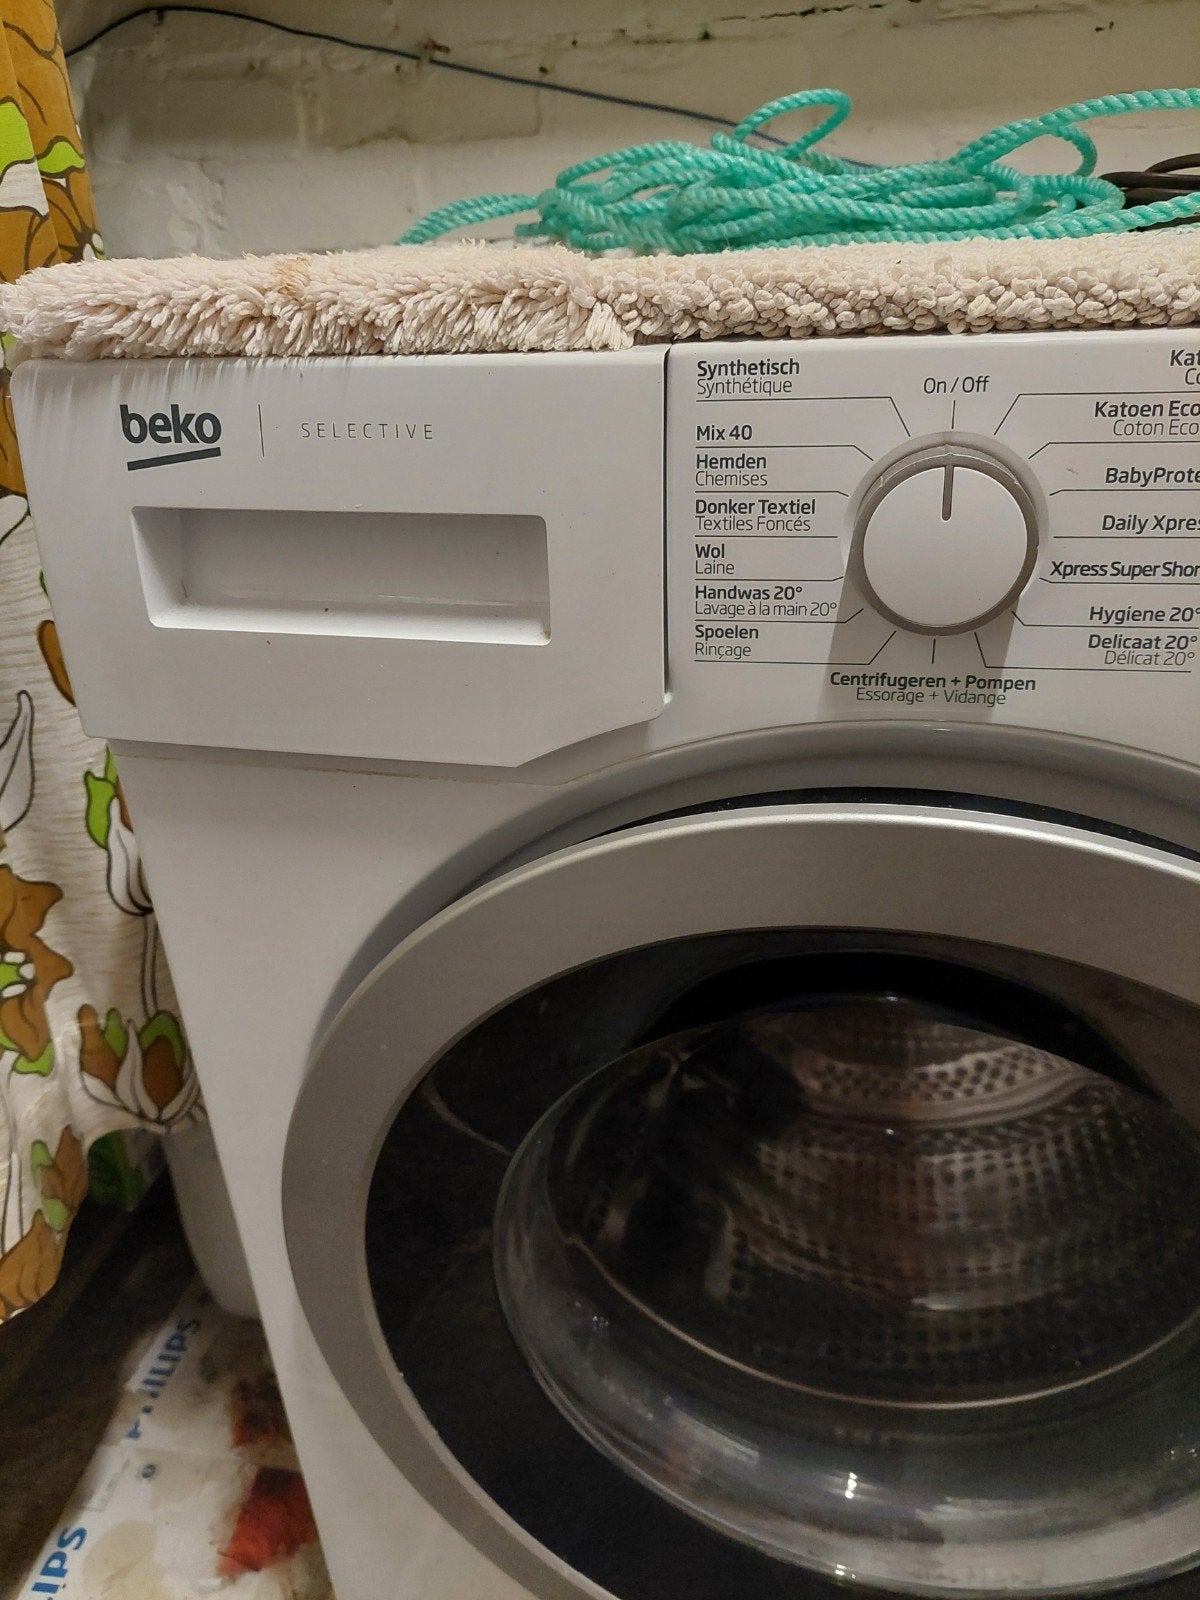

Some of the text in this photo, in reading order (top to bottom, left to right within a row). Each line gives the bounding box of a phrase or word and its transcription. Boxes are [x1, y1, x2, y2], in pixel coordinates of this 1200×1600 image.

[698, 358, 799, 379] Synthetisch
[697, 378, 792, 398] Synthétique
[1095, 400, 1200, 417] Katoen Eco
[120, 404, 221, 444] beko
[302, 422, 433, 440] SELECTIVE
[697, 425, 752, 440] Mix 40
[1113, 419, 1199, 436] Coton Eco
[697, 453, 766, 469] Hemden
[696, 471, 767, 486] Chemises
[696, 499, 815, 514] Donker Textiel
[695, 516, 810, 531] Textiles Foncés
[1102, 515, 1149, 534] Daily
[696, 544, 724, 558] Wol
[696, 560, 734, 574] Laine
[1050, 561, 1108, 579] Xpress
[1110, 561, 1161, 580] Super
[696, 585, 802, 600] Handwas 20°
[696, 601, 837, 618] Lavage à la main 20°
[1090, 606, 1200, 624] Hygiene 20°
[695, 625, 758, 640] Spoelen
[696, 642, 751, 659] Rinçage
[1088, 634, 1197, 650] Delicaat 20°
[1105, 650, 1195, 666] Délicat 20°
[830, 672, 947, 689] Centrifugeren
[965, 675, 1036, 693] Pompen
[856, 687, 924, 705] Essorage
[944, 689, 1006, 707] Vidange
[31, 1526, 87, 1600] IPS
